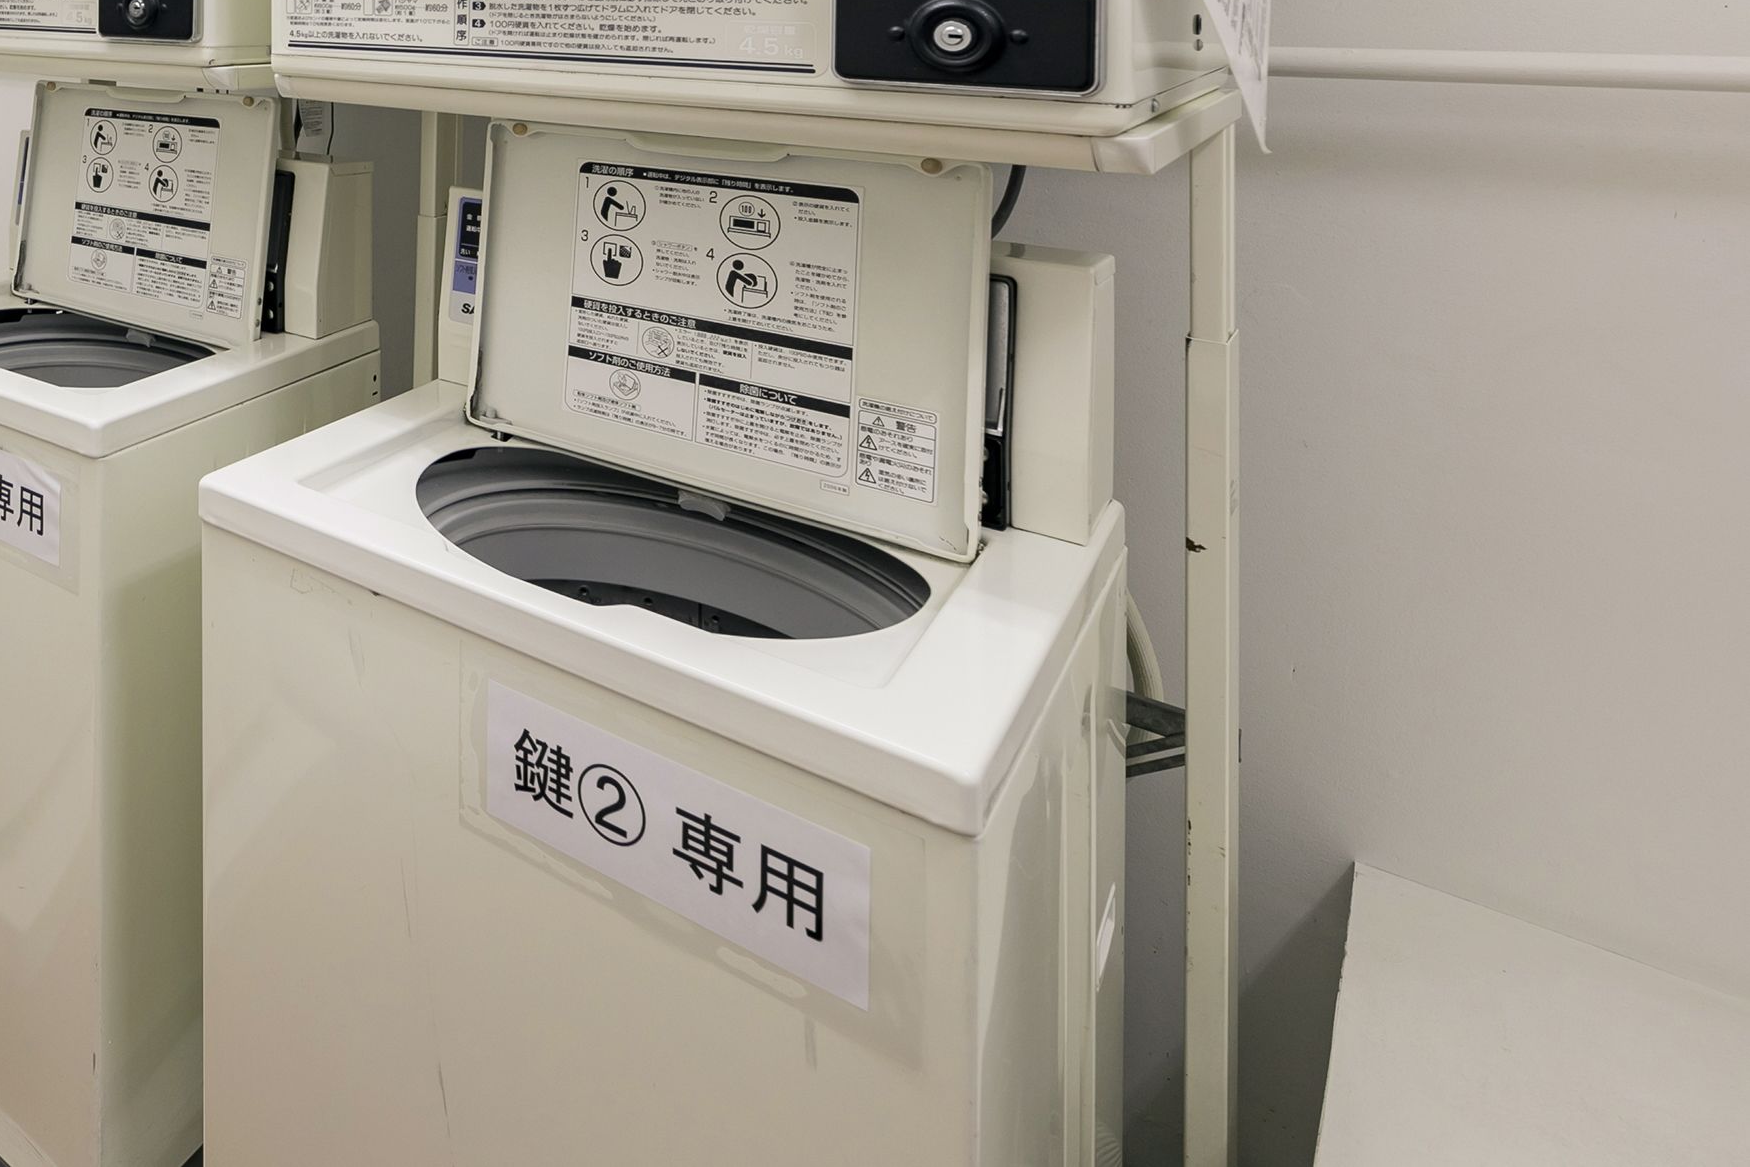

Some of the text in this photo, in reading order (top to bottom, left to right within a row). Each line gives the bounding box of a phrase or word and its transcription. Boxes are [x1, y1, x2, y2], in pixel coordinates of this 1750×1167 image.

[489, 3, 756, 16] 脱水した洗濯物を1枚ずつ広げてドラムに入れてドアを閉じてください。
[490, 21, 662, 33] 100円硬貨を入れてください。乾燥を始めます。
[474, 38, 496, 46] ご注意
[739, 35, 778, 55] 4.5
[592, 164, 634, 176] 洗濯の順序
[585, 177, 589, 188] 1
[708, 191, 718, 203] 2
[581, 230, 589, 241] 3
[706, 248, 715, 260] 4
[584, 300, 697, 329] 硬貨を投入するときのご注意
[588, 351, 671, 377] ソフト剤のご使用方法
[740, 384, 797, 404] 除菌について
[896, 421, 916, 433] 警告
[513, 728, 824, 943] 鍵② 専用
